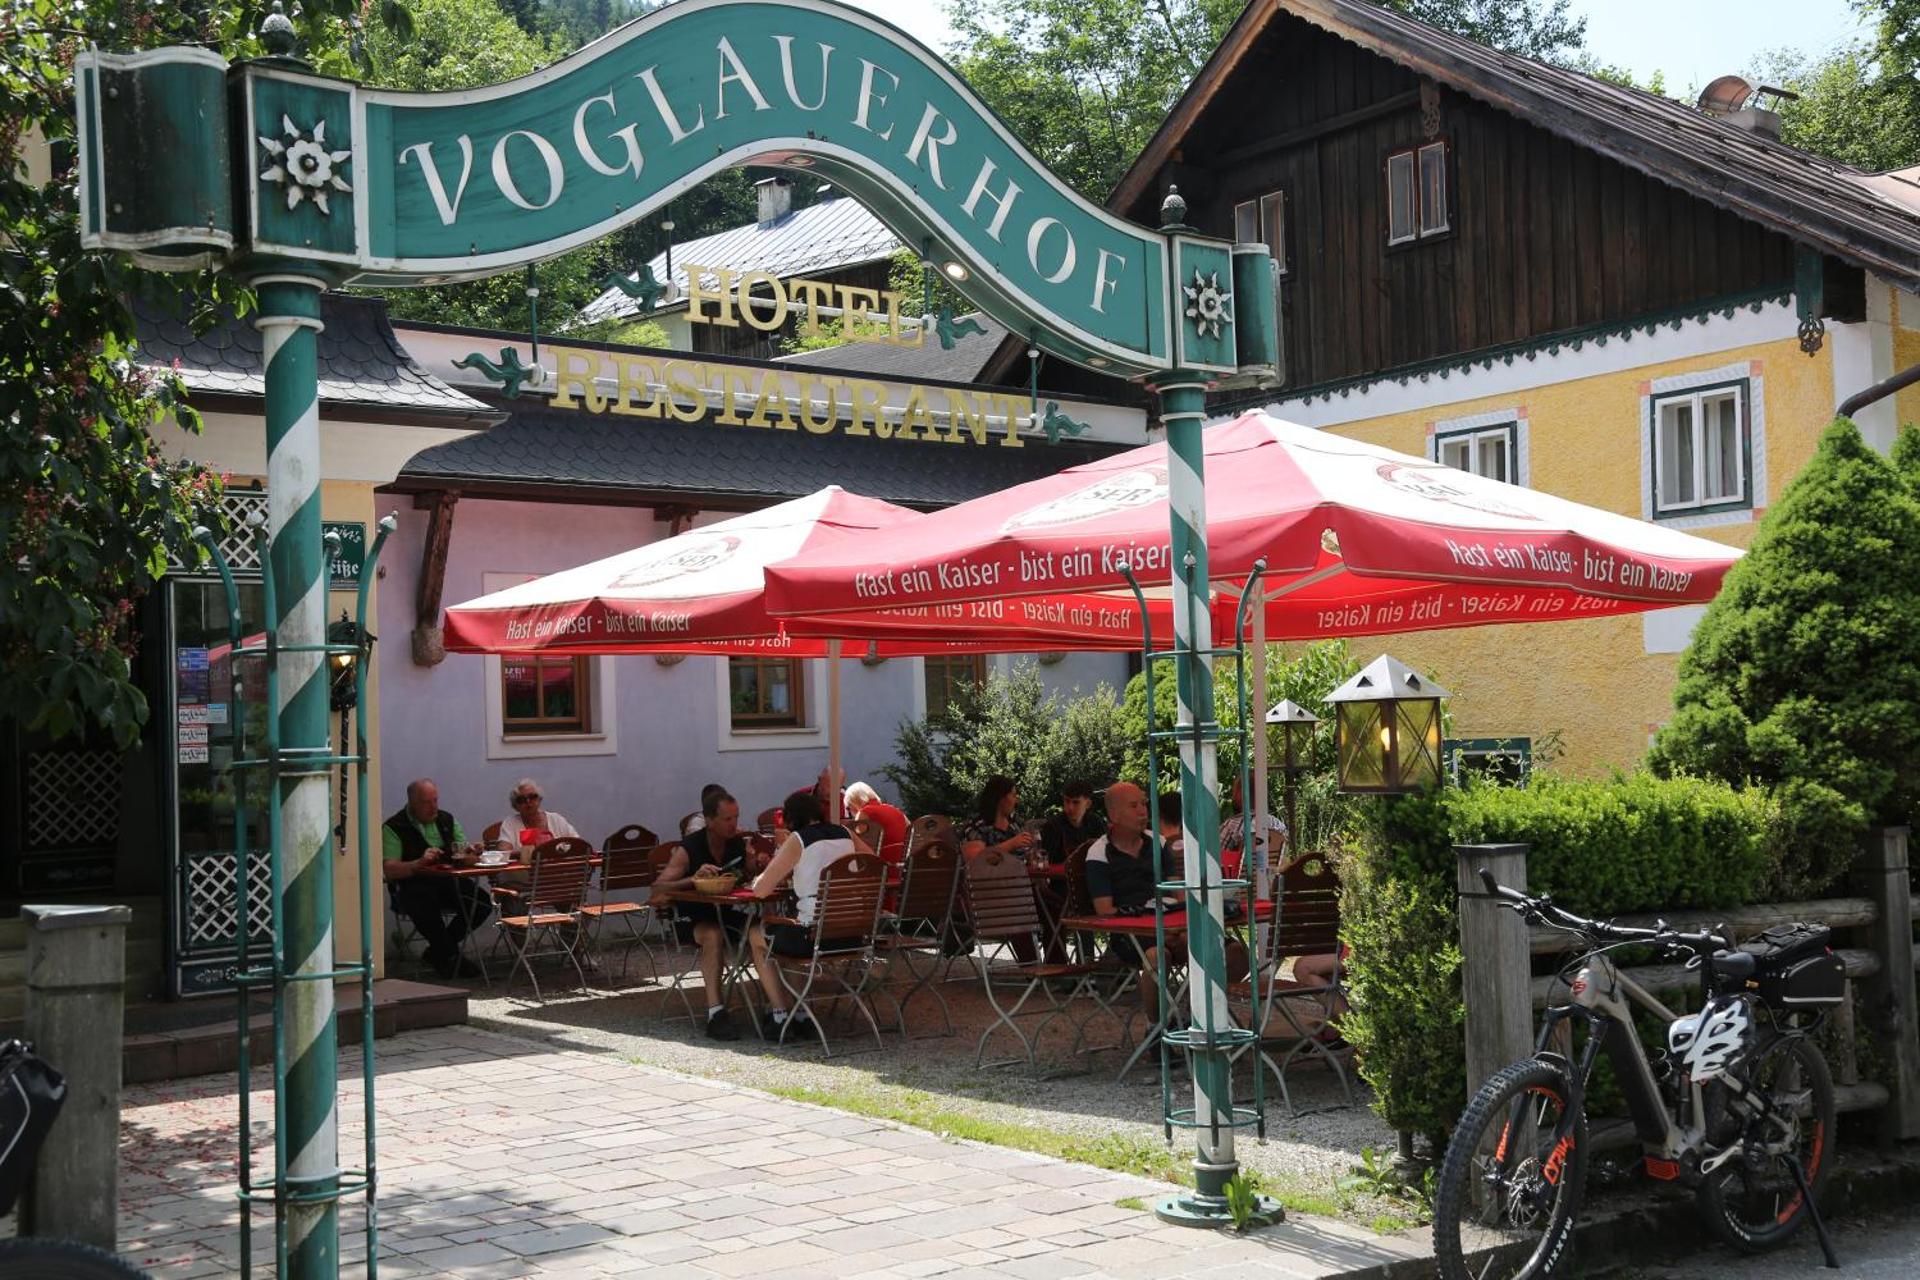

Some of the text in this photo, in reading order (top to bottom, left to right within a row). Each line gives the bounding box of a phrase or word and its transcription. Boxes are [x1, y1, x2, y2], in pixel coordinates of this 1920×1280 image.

[399, 35, 1127, 314] VOGLAUERHOF
[681, 264, 924, 349] HOTEL
[548, 346, 1032, 448] RESTAURANT
[855, 567, 897, 598] Hast
[902, 564, 932, 593] ein
[937, 559, 1001, 589] Kaiser
[1020, 551, 1055, 582] bist
[1061, 549, 1093, 577] ein
[1445, 539, 1493, 567] Hast
[1496, 543, 1526, 569] ein
[1584, 548, 1614, 583] bist
[1620, 557, 1644, 588] ein
[1649, 563, 1693, 593] Kaiser
[506, 620, 531, 640] Hast
[535, 616, 552, 637] ein
[552, 613, 593, 636] Kaiser
[604, 608, 626, 633] bist
[628, 610, 646, 633] ein
[651, 610, 691, 632] Kaiser
